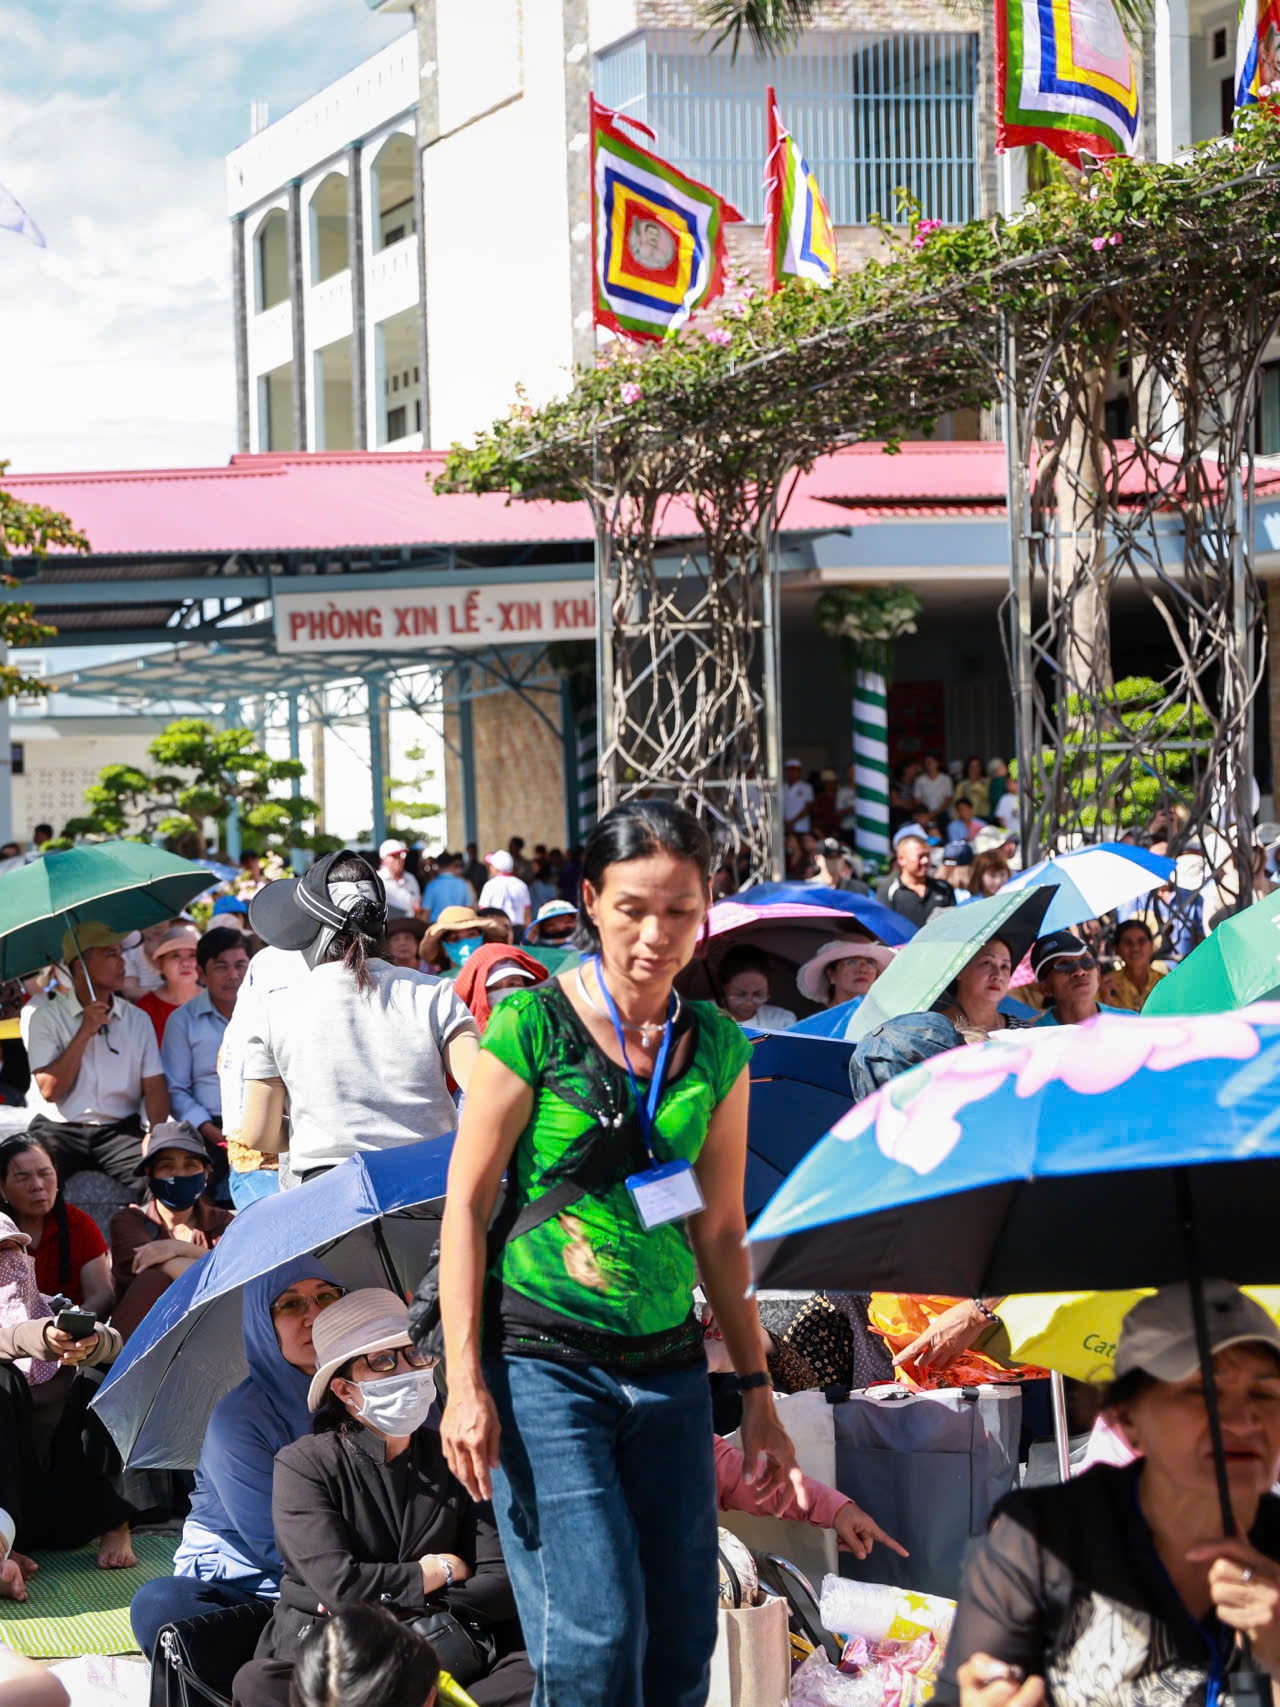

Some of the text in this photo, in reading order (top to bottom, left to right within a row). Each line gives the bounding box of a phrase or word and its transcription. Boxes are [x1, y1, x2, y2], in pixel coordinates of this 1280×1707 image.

[289, 602, 383, 641] PHÒNG
[394, 604, 438, 637] XIN
[1082, 1334, 1117, 1359] Cat
